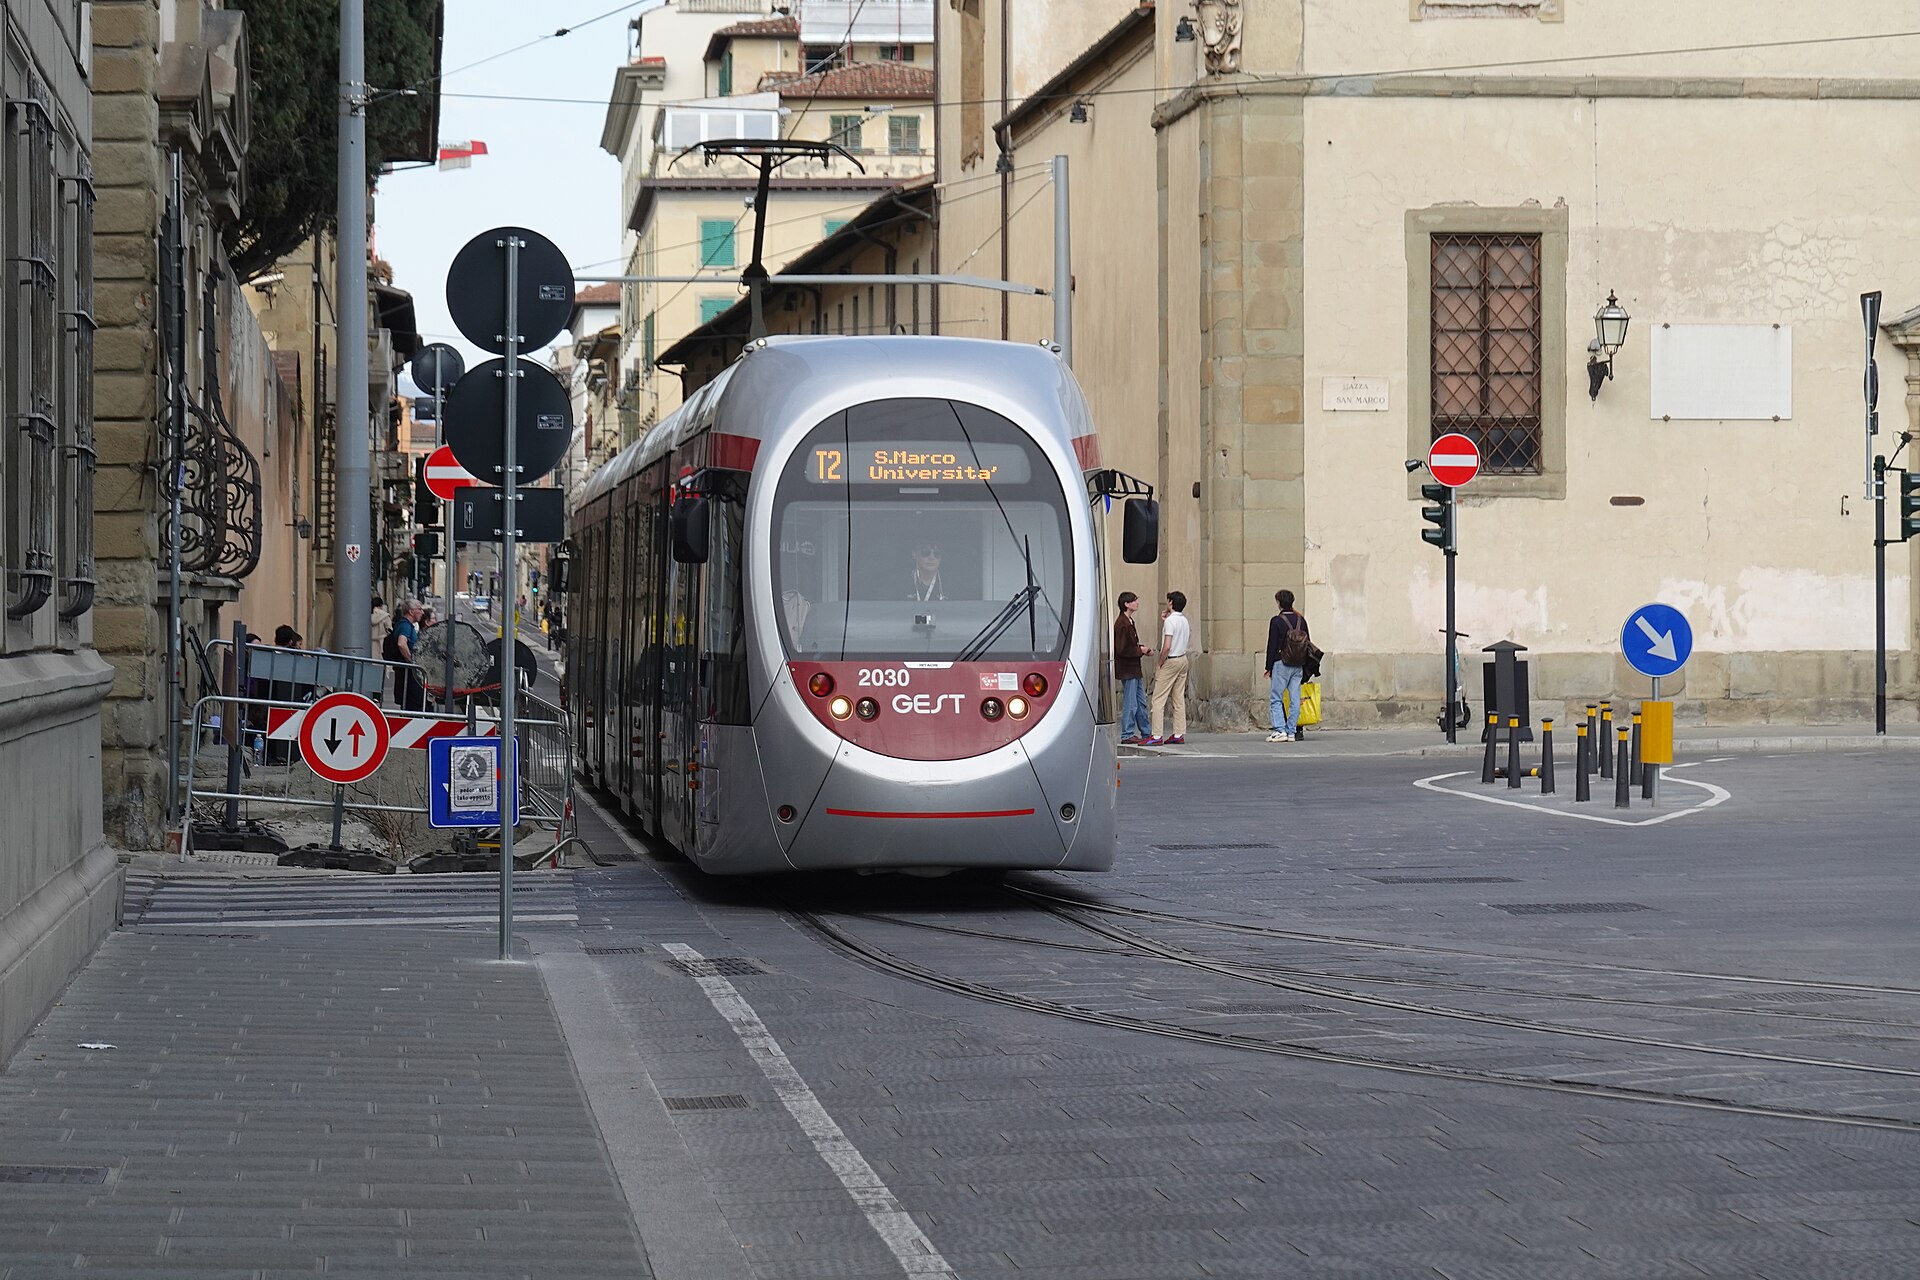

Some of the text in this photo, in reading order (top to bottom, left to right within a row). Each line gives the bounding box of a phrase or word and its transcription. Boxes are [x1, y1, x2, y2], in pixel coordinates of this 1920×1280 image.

[1336, 396, 1386, 404] SAN MARCO
[815, 450, 842, 480] T2
[874, 450, 956, 465] S.Marco
[869, 466, 998, 480] Universita'
[858, 668, 911, 687] 2030
[891, 694, 966, 714] GEST
